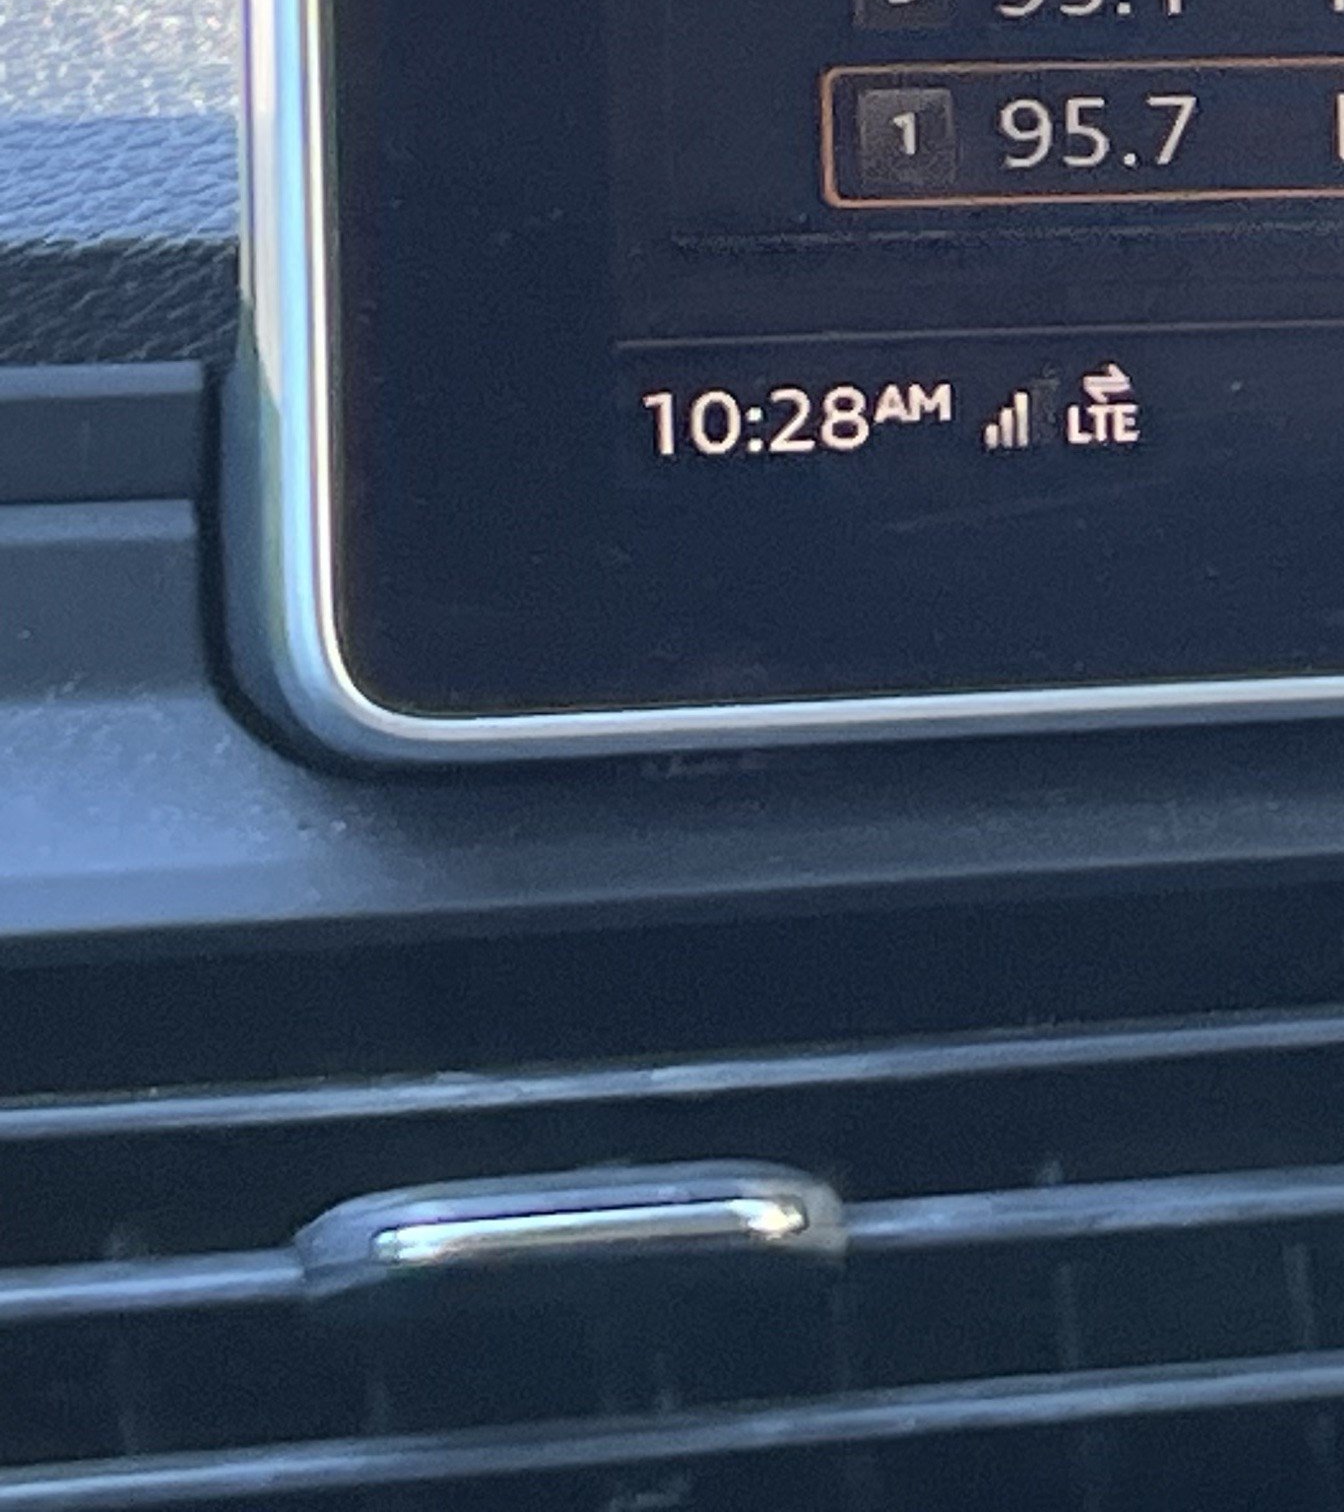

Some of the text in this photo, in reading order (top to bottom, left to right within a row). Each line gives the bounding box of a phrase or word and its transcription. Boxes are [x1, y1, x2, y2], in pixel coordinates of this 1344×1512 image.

[893, 115, 917, 156] 1
[1001, 95, 1196, 168] 95.7
[1067, 404, 1140, 444] LTE
